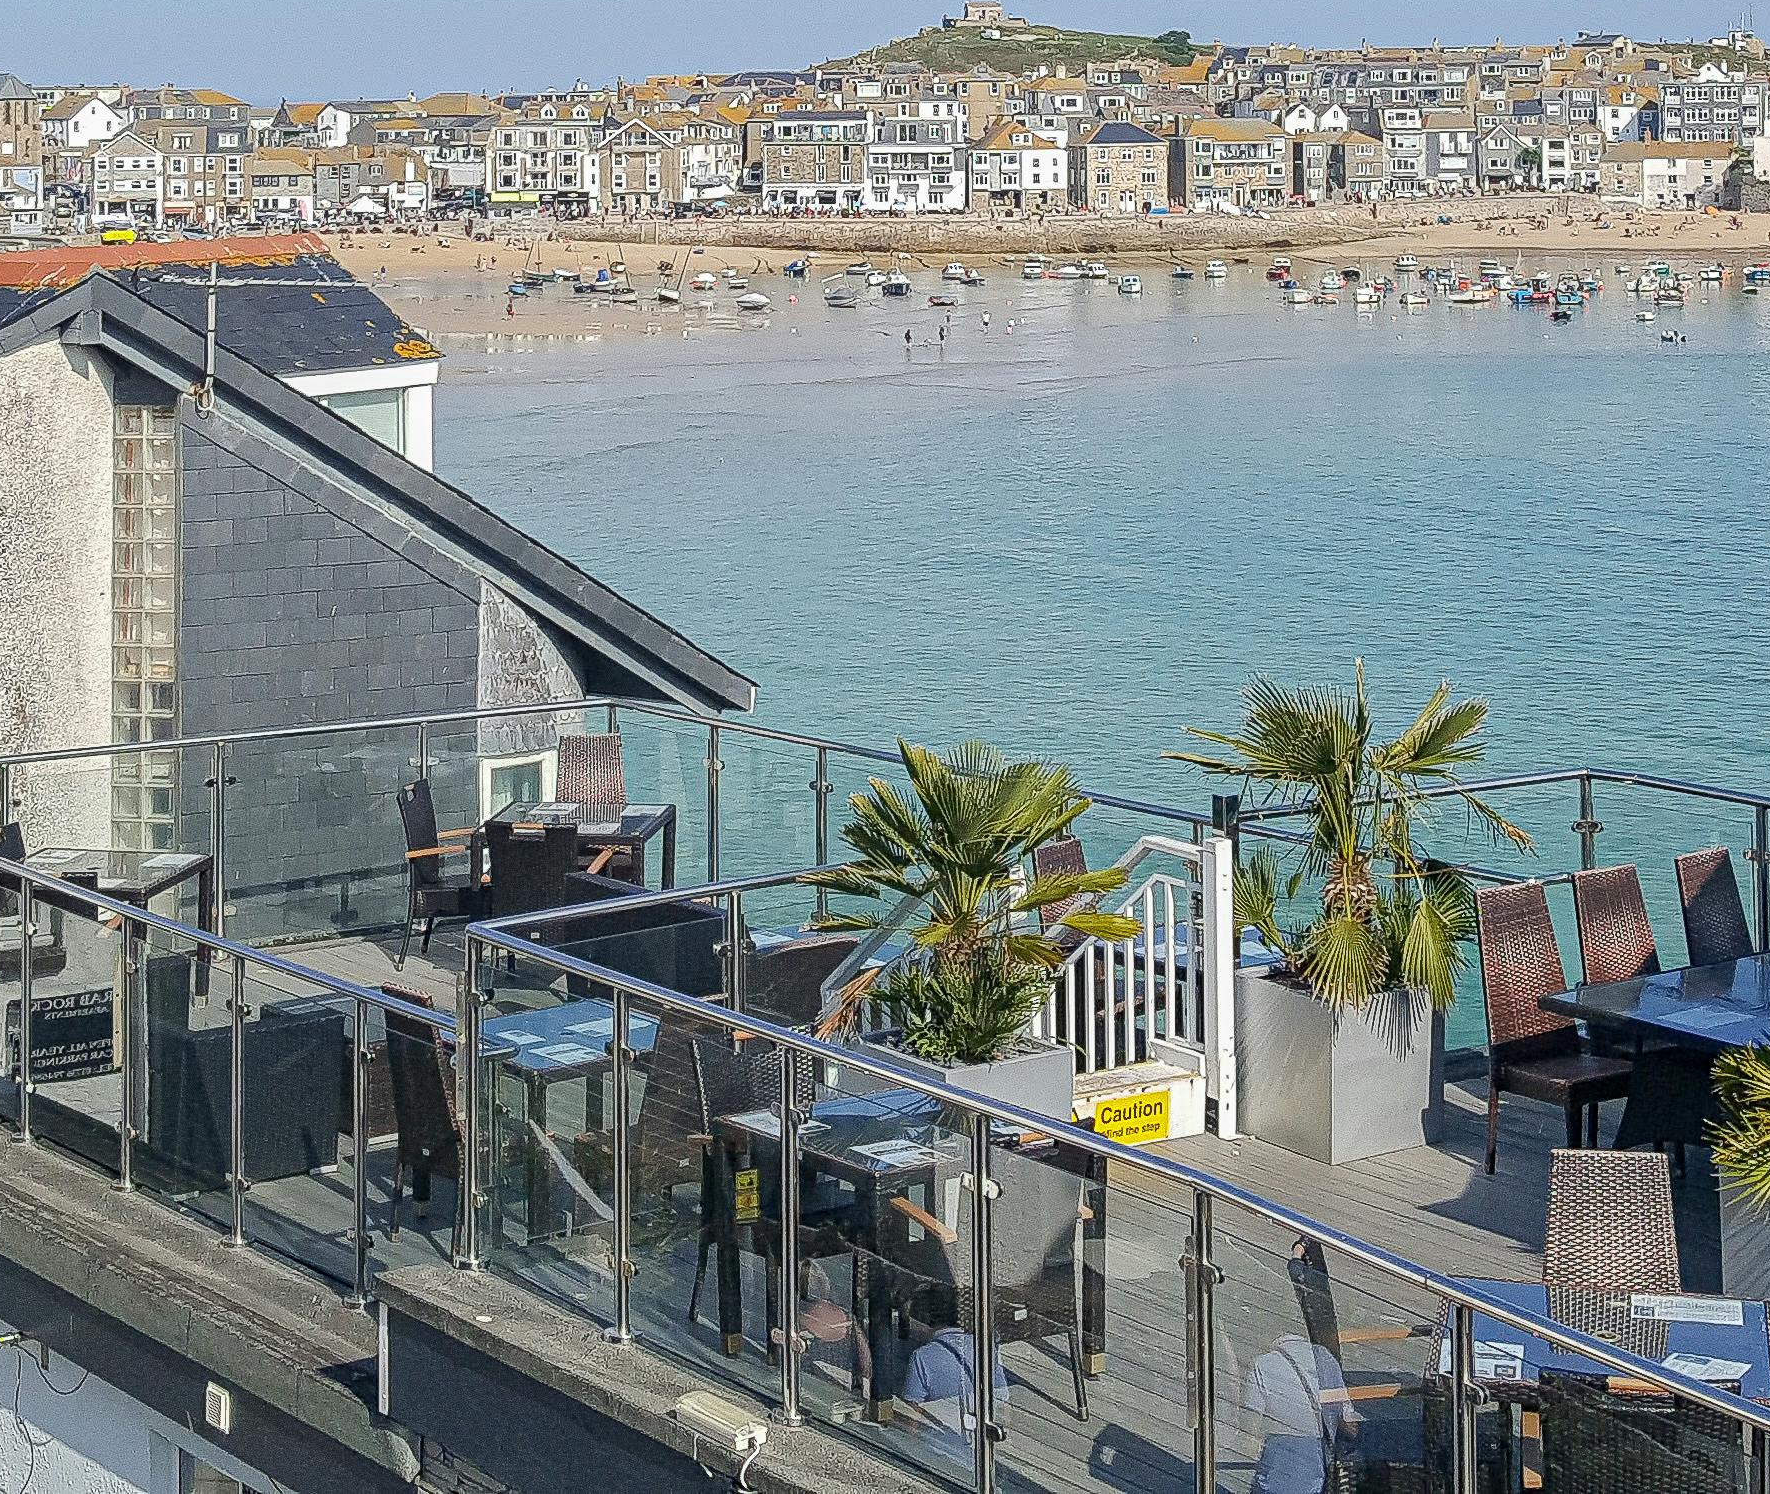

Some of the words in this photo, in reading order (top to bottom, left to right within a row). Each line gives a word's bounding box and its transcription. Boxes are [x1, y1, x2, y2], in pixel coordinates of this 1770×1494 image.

[1101, 1101, 1163, 1124] Caution
[1125, 1126, 1140, 1136] the
[1141, 1122, 1161, 1133] step
